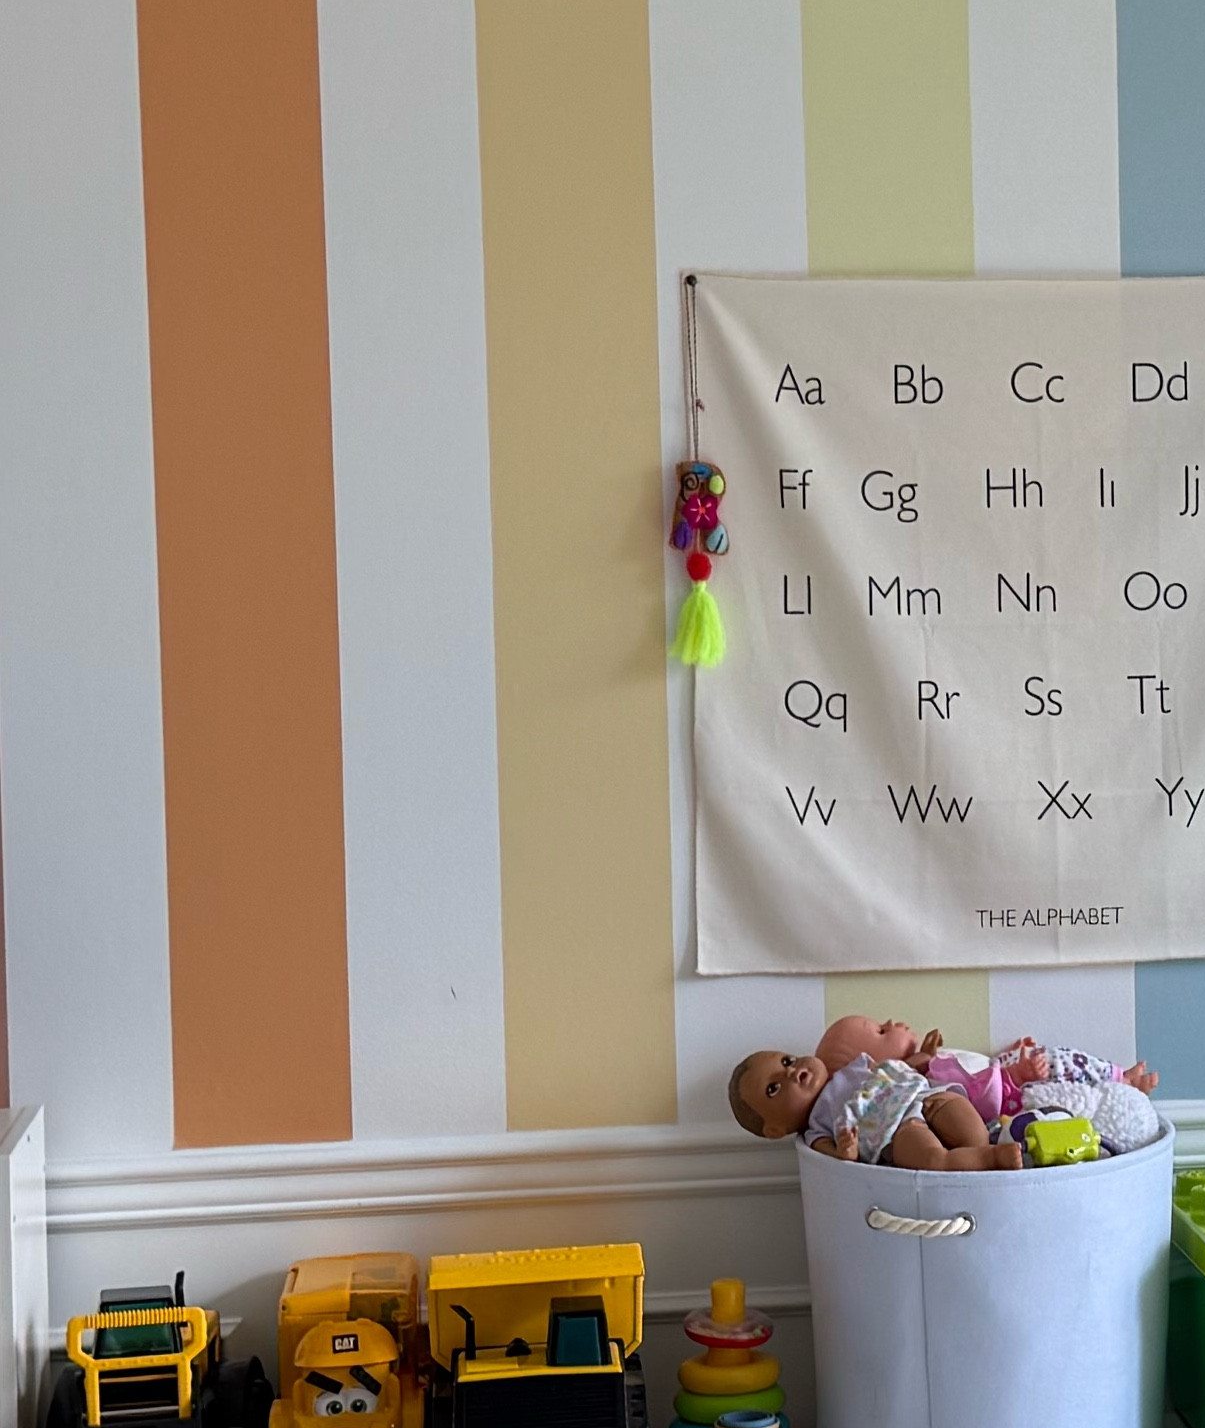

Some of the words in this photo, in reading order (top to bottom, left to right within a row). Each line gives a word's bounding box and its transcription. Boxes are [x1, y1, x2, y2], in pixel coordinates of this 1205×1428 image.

[774, 363, 827, 406] Aa
[893, 363, 944, 405] Bb
[1010, 361, 1065, 404] Cc
[1131, 360, 1189, 403] Dd
[778, 468, 814, 511] Ff
[860, 469, 919, 524] Gg
[985, 467, 1044, 509] Hh
[1178, 464, 1200, 518] Jj
[783, 574, 812, 616] Ll
[868, 575, 942, 617] Mm
[997, 571, 1057, 613] Nn
[1123, 570, 1188, 612] Oo
[784, 679, 848, 733] Qq
[917, 680, 961, 721] Rr
[1024, 675, 1063, 717] Ss
[1126, 674, 1172, 715] Tt
[784, 785, 837, 827] Vv
[887, 783, 974, 825] Ww
[1037, 779, 1093, 821] Xx
[1154, 775, 1205, 829] Yy
[975, 909, 1016, 929] THE
[1021, 906, 1125, 928] ALPHABET
[334, 1336, 356, 1351] CAT
